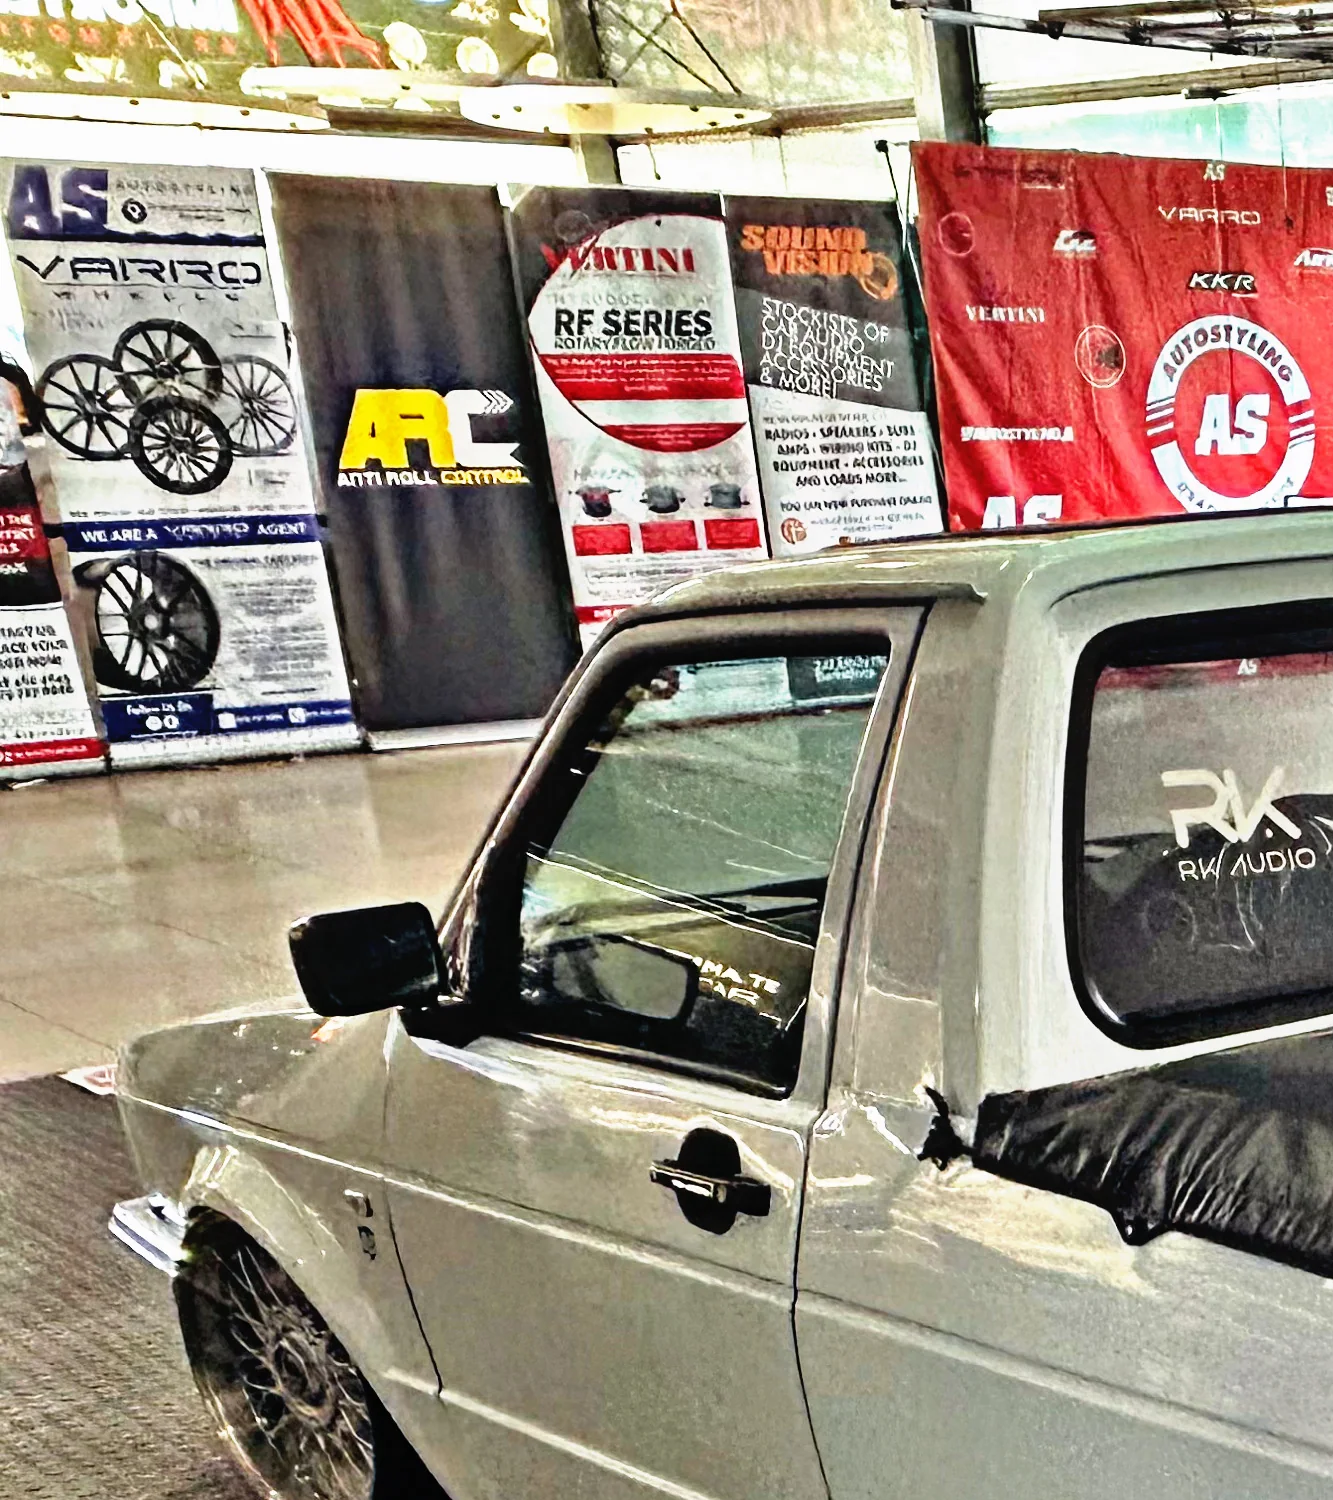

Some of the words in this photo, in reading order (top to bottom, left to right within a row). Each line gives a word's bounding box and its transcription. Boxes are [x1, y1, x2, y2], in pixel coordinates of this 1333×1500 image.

[1203, 163, 1225, 181] AS
[10, 165, 108, 235] AS
[1158, 206, 1261, 225] VARRO
[741, 225, 867, 250] SOUND
[16, 254, 262, 284] VARRO
[763, 250, 873, 276] VISION
[1189, 272, 1256, 291] KKR
[555, 308, 595, 336] RF
[602, 308, 713, 337] SERIES
[762, 297, 858, 335] STOCKISTS
[864, 322, 889, 343] OF
[762, 315, 799, 342] CAR
[803, 326, 864, 353] AUDIO
[759, 350, 883, 392] ACCESSORIES
[789, 338, 895, 378] EQUIPMENT
[1163, 324, 1293, 383] AUTOSTYLING
[339, 388, 526, 469] ARC
[1195, 393, 1271, 456] AS
[337, 470, 383, 488] ANTI
[386, 470, 438, 487] ROLL
[440, 468, 531, 486] CONTROL
[1160, 765, 1302, 849] RK
[1177, 856, 1221, 882] RK
[1230, 847, 1317, 877] AUDIO
